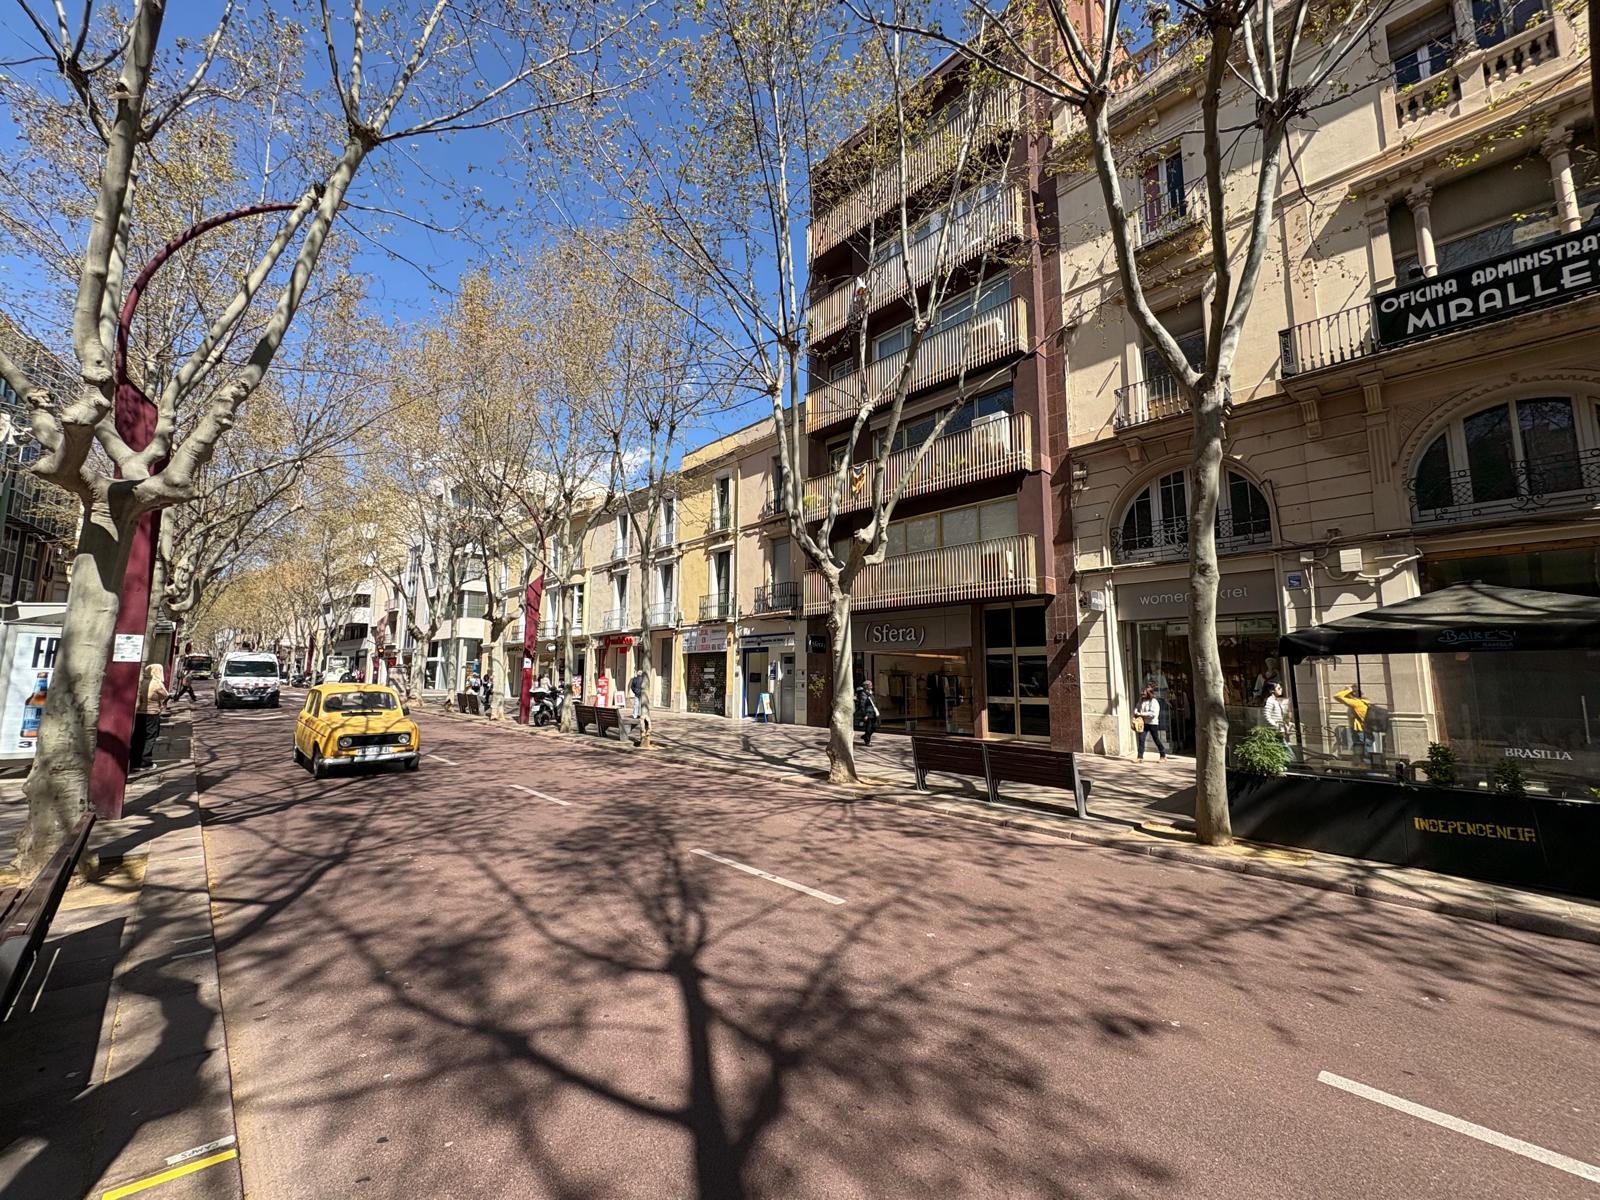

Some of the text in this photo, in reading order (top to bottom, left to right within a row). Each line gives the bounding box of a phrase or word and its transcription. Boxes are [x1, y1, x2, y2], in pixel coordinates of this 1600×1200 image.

[1380, 233, 1600, 313] OFICINA ADMINISTRA
[1406, 259, 1600, 334] MIRALLE
[1503, 747, 1573, 761] BRASILIA
